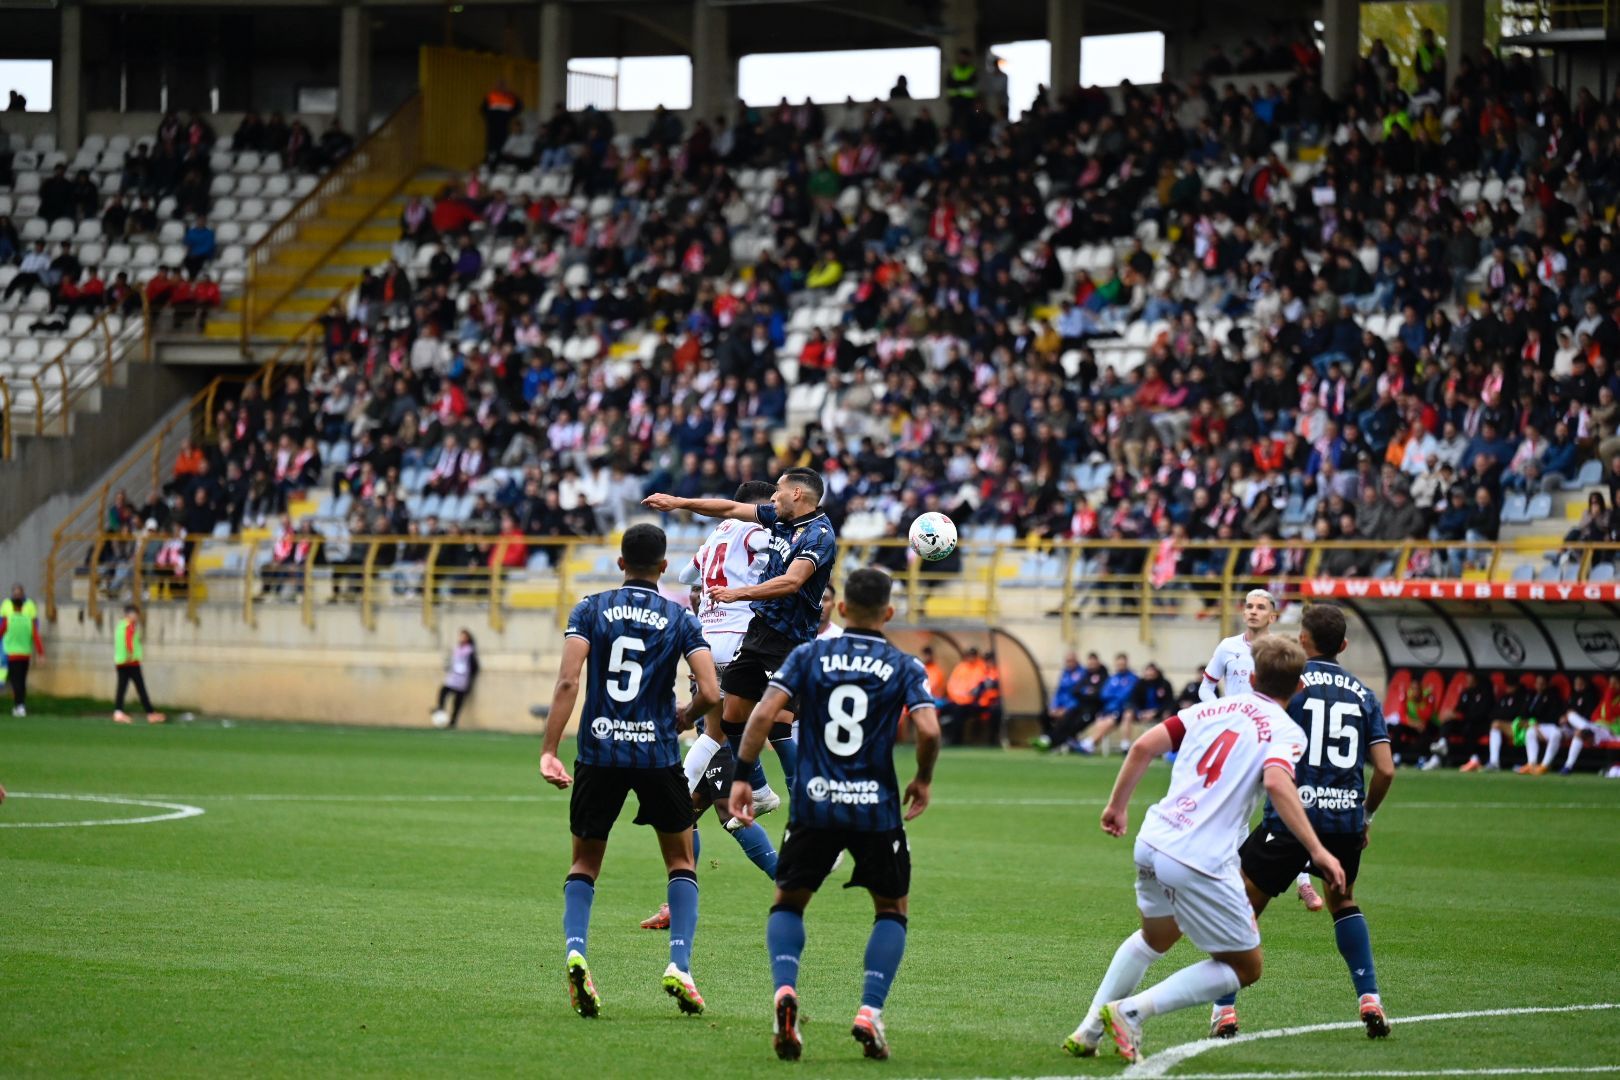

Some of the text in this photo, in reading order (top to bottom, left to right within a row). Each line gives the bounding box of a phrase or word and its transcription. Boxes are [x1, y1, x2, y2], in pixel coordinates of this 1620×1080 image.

[602, 605, 669, 631] YOUNESS
[606, 635, 646, 703] 5
[820, 654, 894, 682] ZALAZAR
[1300, 671, 1369, 703] IEGO GLEZ
[613, 719, 655, 732] DARYSO
[824, 684, 869, 757] 8
[1302, 697, 1363, 769] 15
[613, 730, 656, 744] MOTOR
[1196, 728, 1240, 789] 4
[831, 791, 880, 804] MOTOR
[1316, 786, 1359, 799] DARYSO
